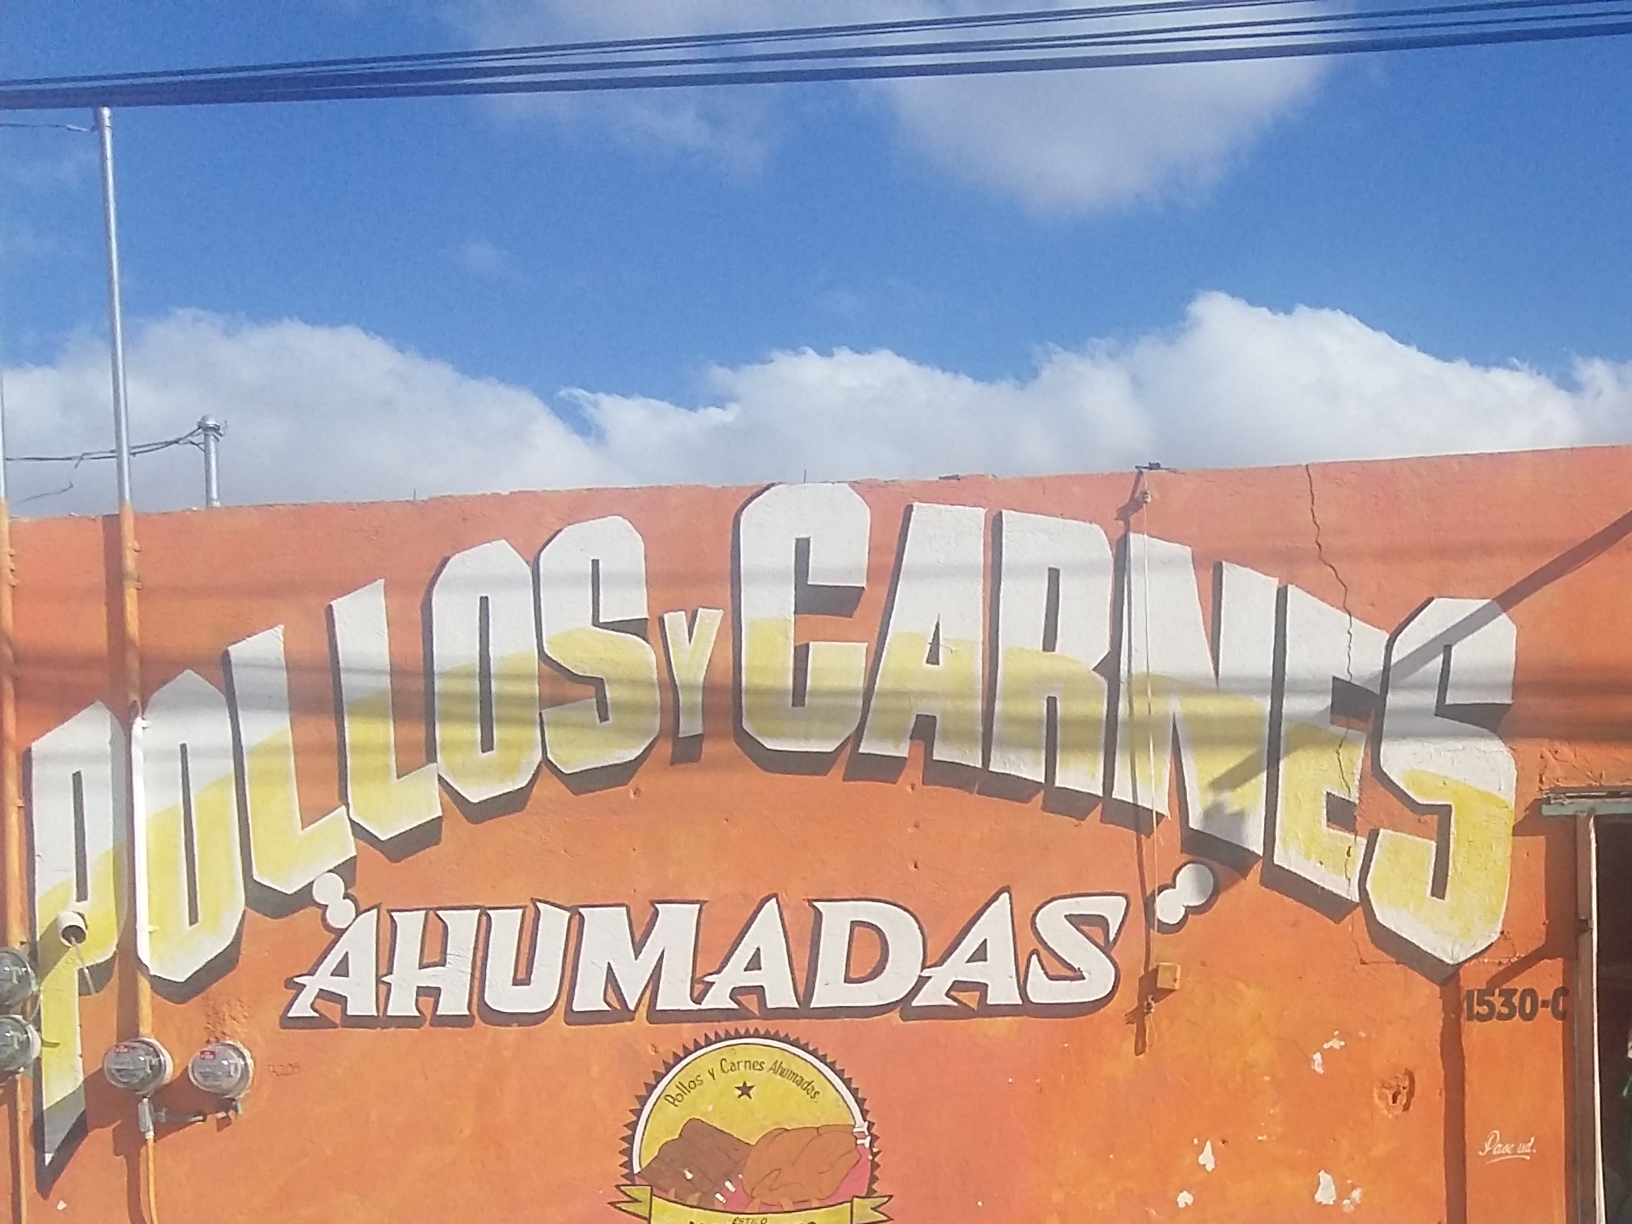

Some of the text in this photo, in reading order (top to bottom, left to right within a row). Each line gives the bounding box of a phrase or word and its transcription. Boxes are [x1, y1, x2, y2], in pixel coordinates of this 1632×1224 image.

[28, 482, 1517, 1175] POLLOS Y CARNES
[285, 888, 1127, 1022] AHUMADAS
[1465, 986, 1570, 1022] 1530-C
[664, 1073, 704, 1107] Pollos
[720, 1057, 766, 1074] Carnes
